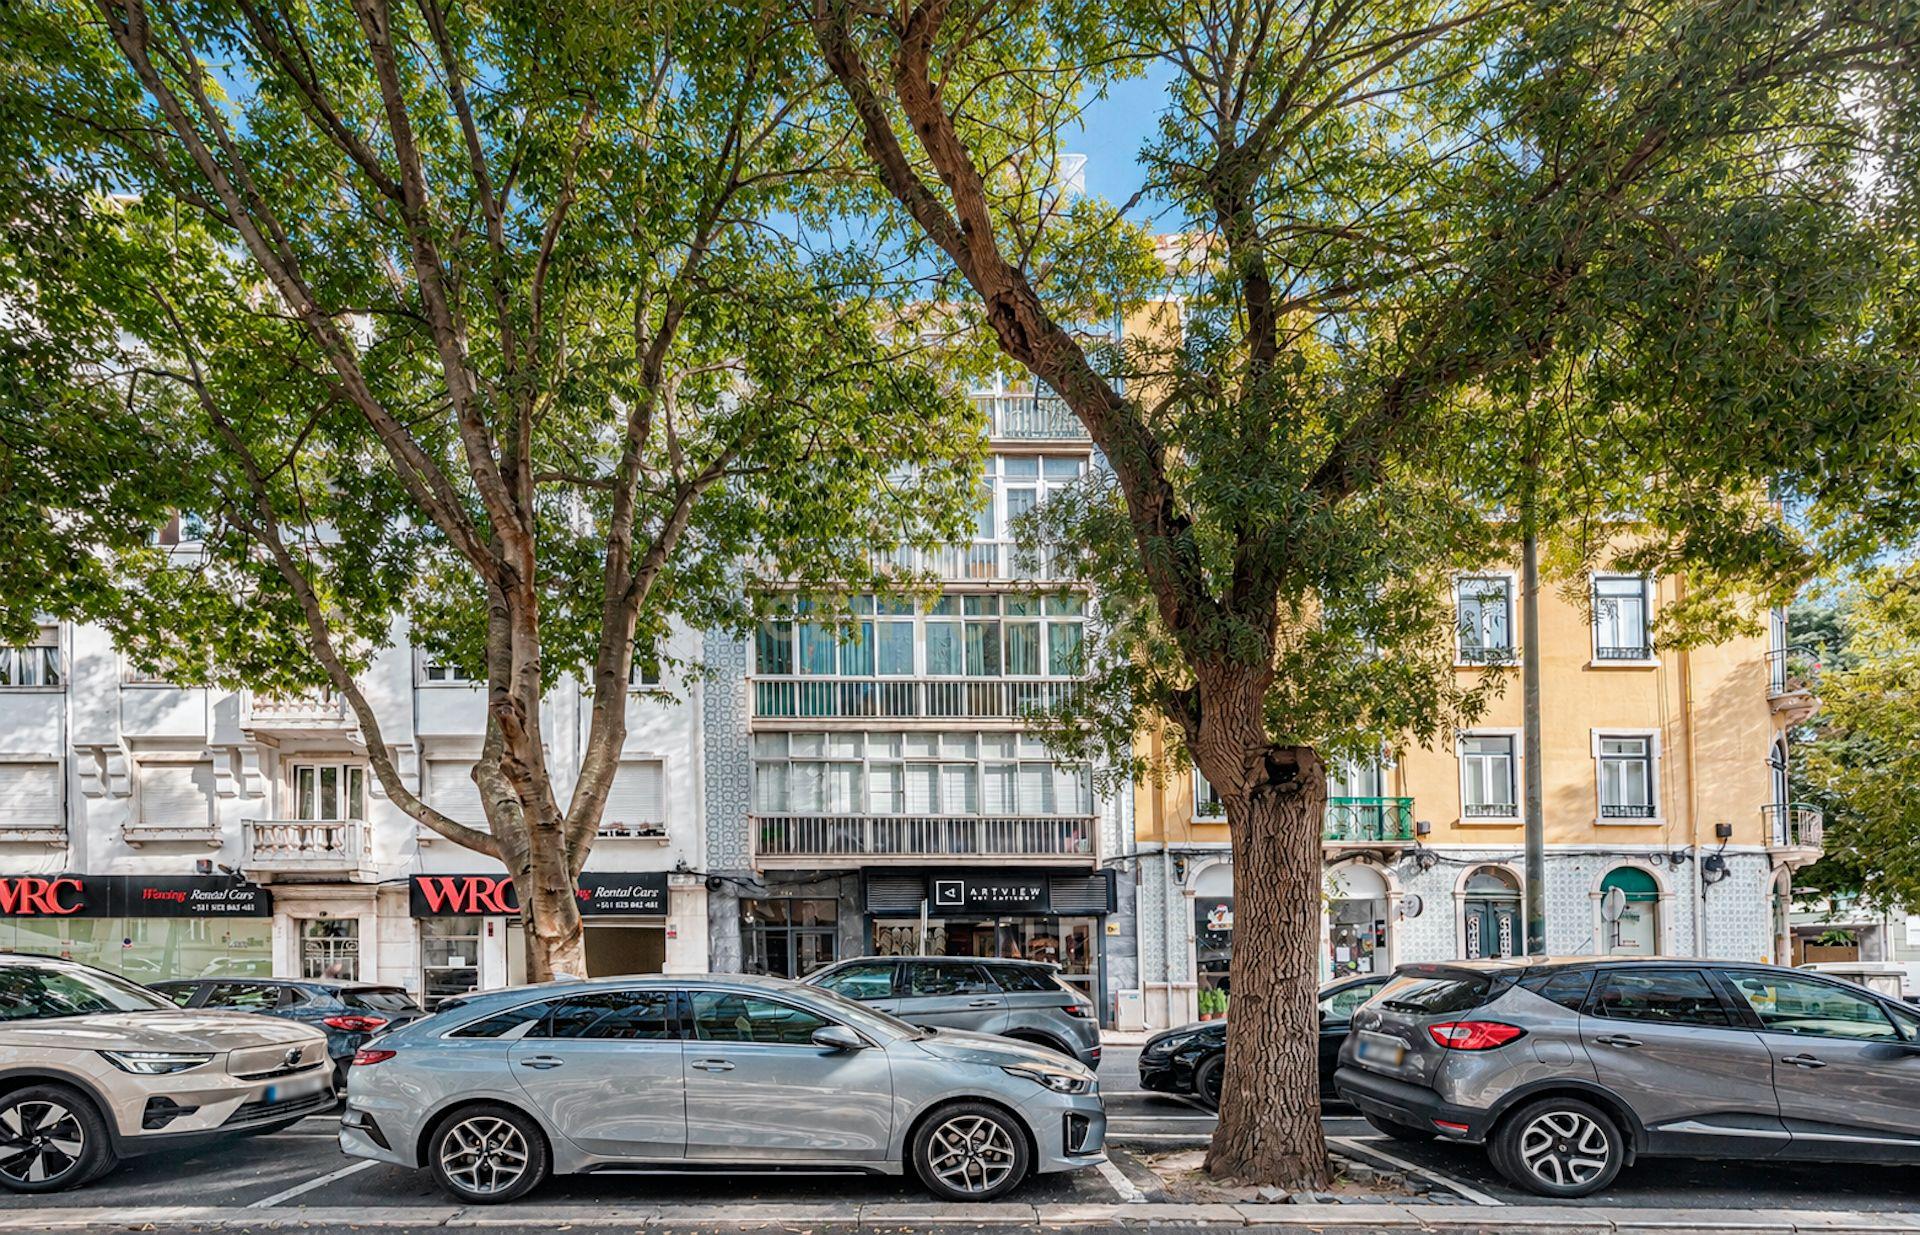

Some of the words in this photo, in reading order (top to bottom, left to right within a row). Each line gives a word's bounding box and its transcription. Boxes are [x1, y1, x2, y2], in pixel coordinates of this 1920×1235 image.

[190, 888, 228, 900] Rental
[228, 889, 255, 900] Cars
[415, 877, 521, 913] WRC
[594, 885, 633, 898] Rental
[633, 885, 659, 898] Cars
[970, 887, 1040, 896] ARTVIEW
